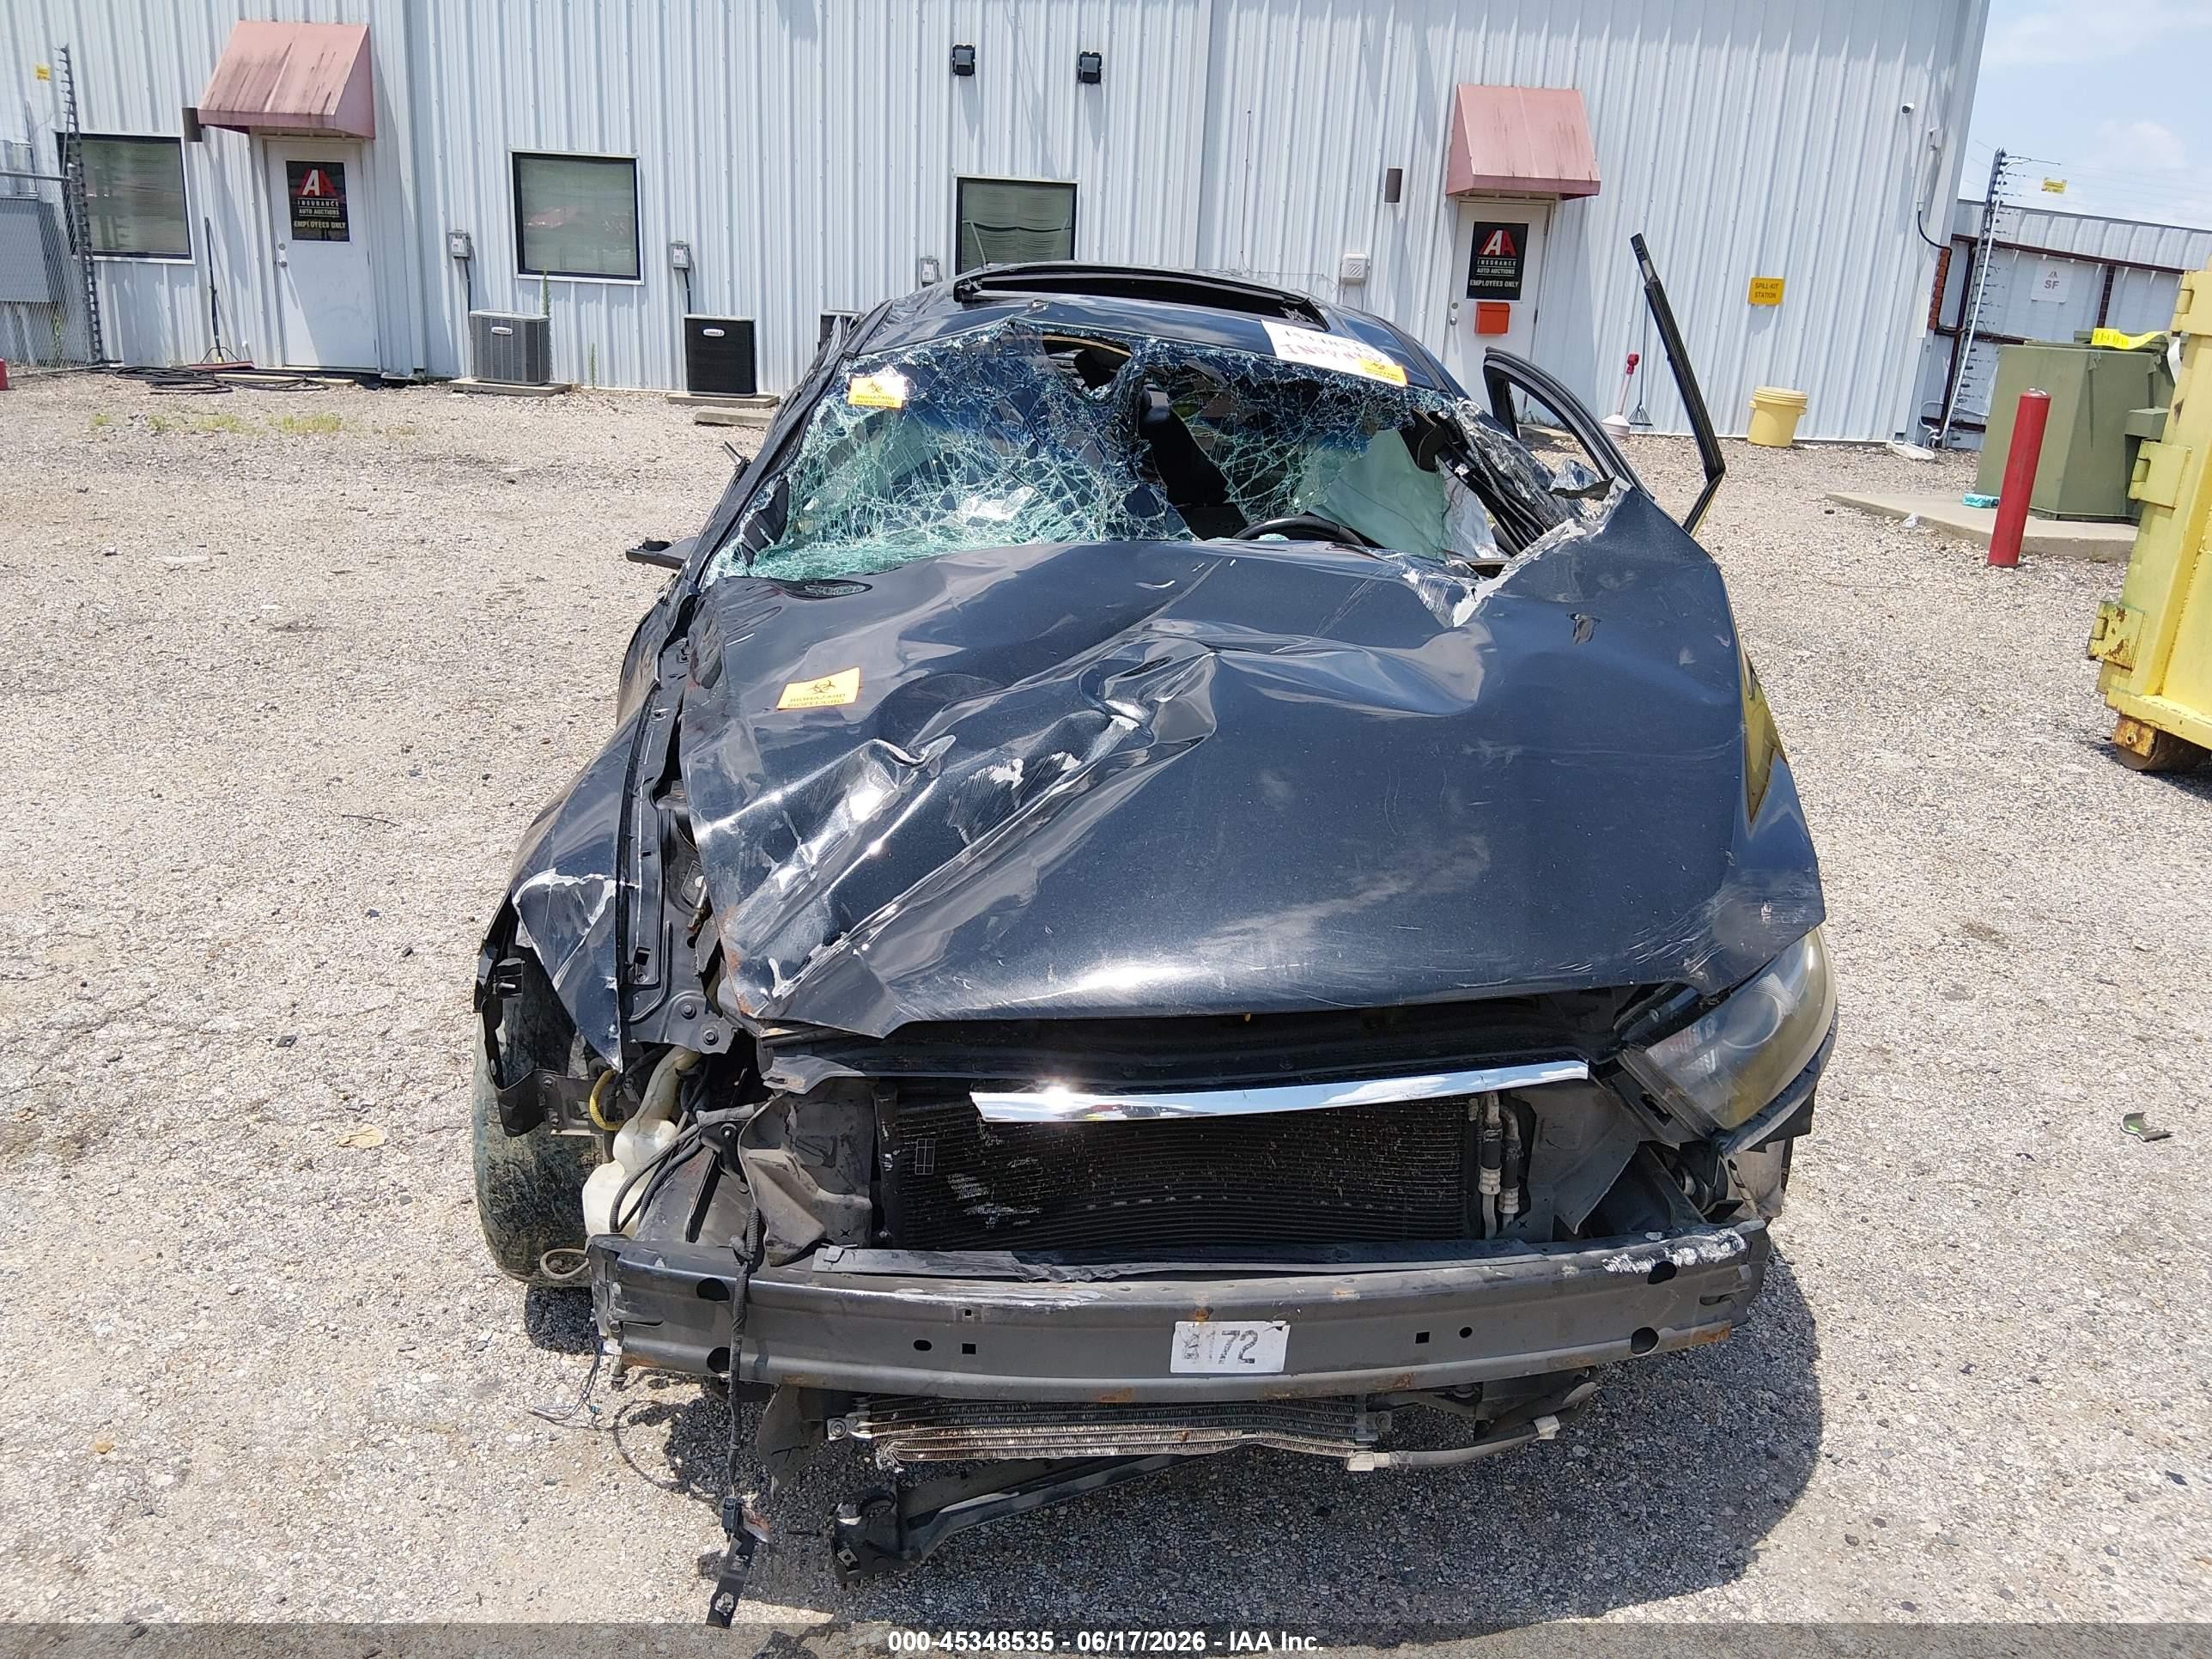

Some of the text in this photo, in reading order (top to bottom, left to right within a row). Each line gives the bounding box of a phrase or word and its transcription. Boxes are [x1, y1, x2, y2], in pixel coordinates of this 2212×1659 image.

[294, 220, 330, 228] EMPLOYEES
[1469, 279, 1504, 288] EMPLOYEES
[2045, 280, 2059, 289] SF
